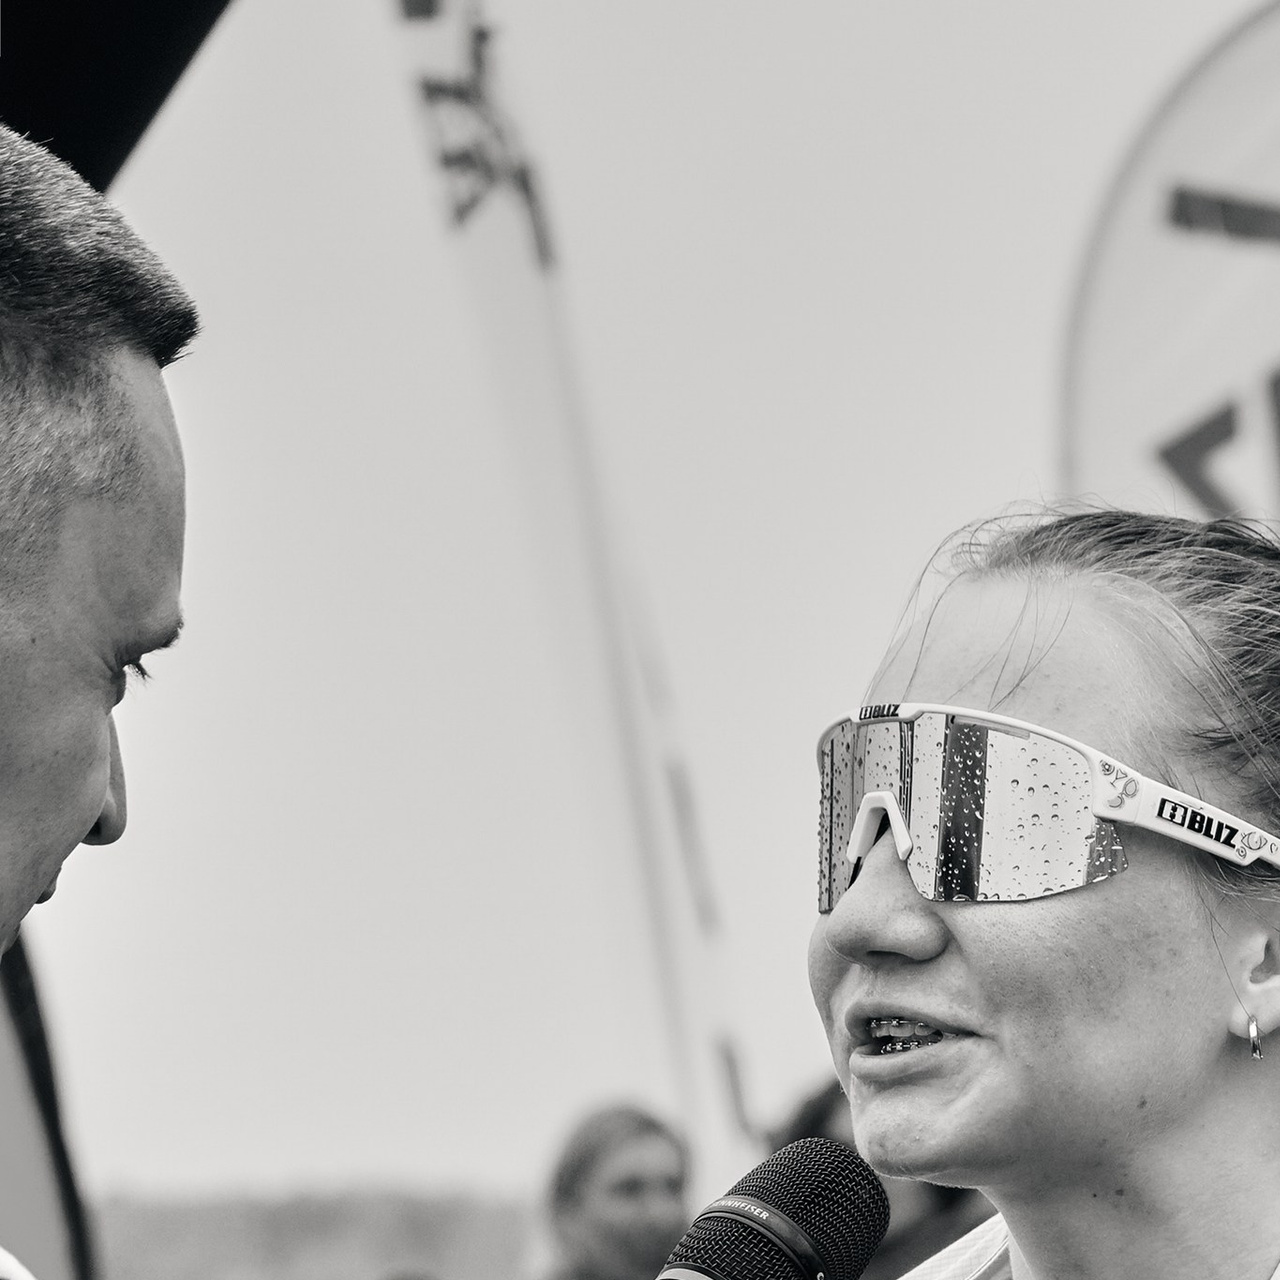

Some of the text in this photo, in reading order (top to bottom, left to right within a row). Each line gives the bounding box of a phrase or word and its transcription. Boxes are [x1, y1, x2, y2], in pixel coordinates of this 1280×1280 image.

[872, 704, 900, 719] BLIZ
[1187, 809, 1239, 849] BLIZ
[713, 1200, 769, 1220] ENNHEISER
